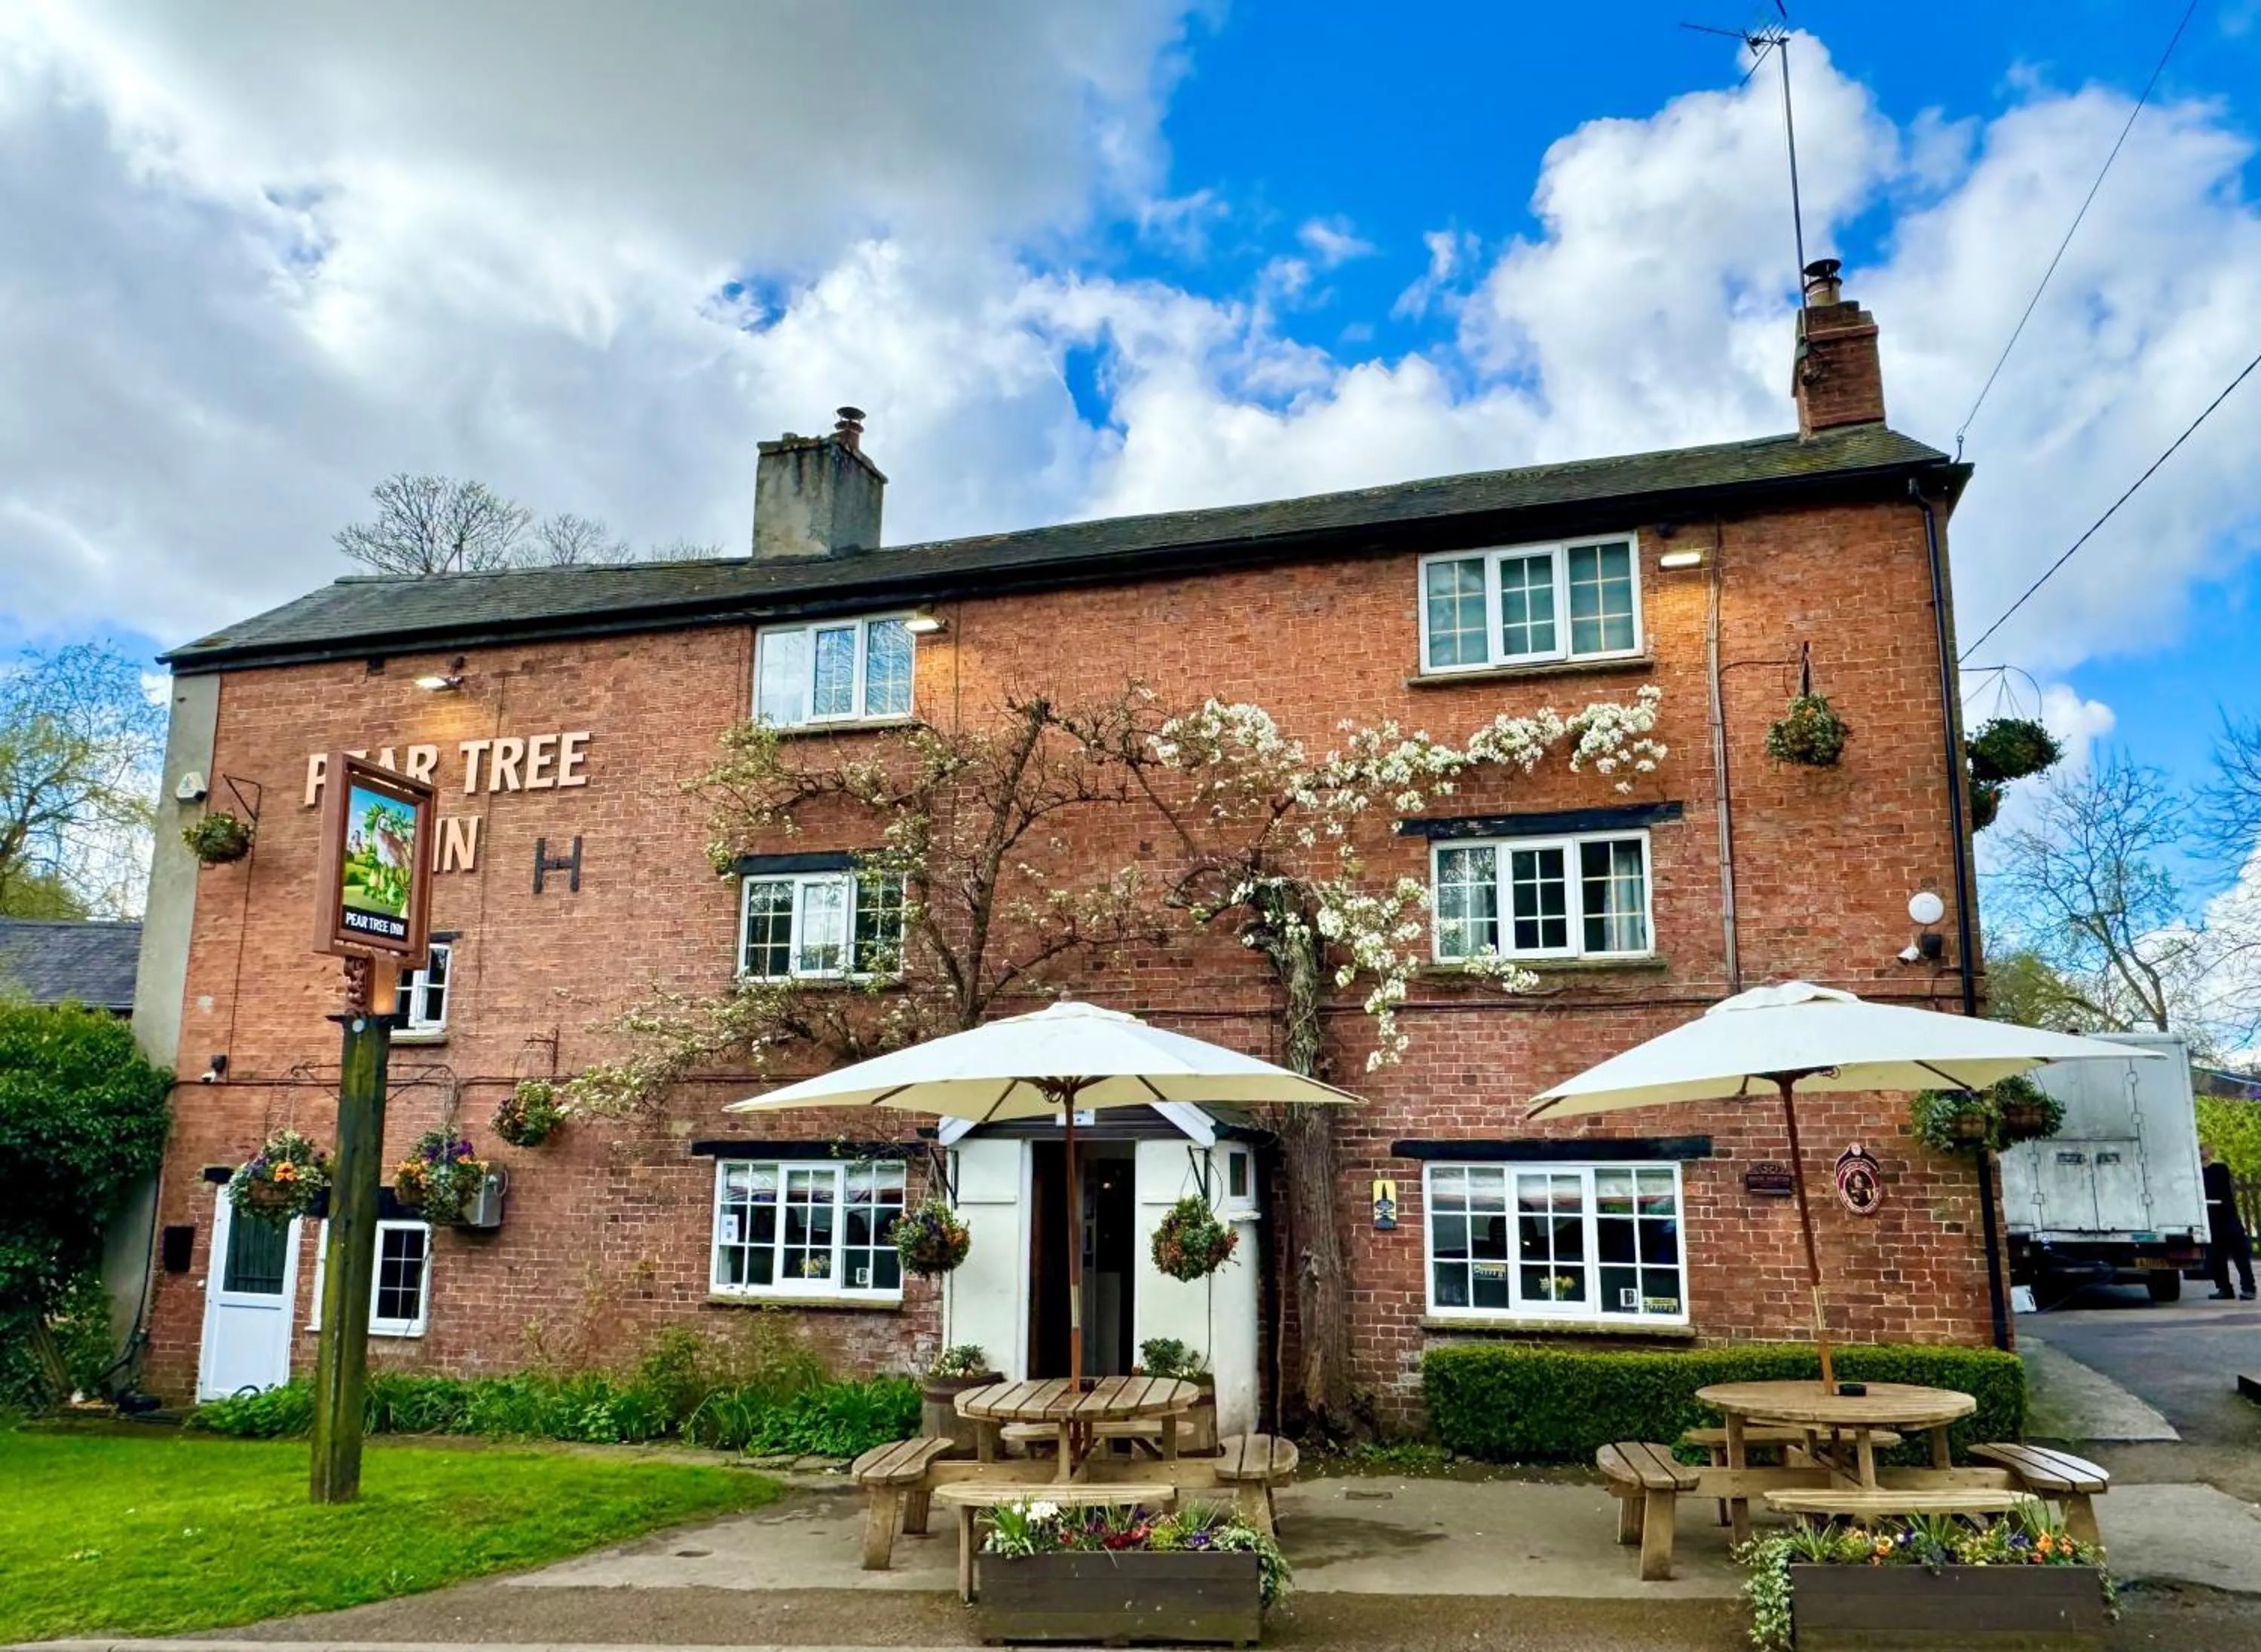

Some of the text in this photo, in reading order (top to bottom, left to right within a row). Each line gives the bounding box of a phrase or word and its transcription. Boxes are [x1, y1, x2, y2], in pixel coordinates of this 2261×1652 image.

[304, 731, 591, 807] PR TREE
[346, 911, 368, 928] PEAR
[369, 916, 390, 933] TREE
